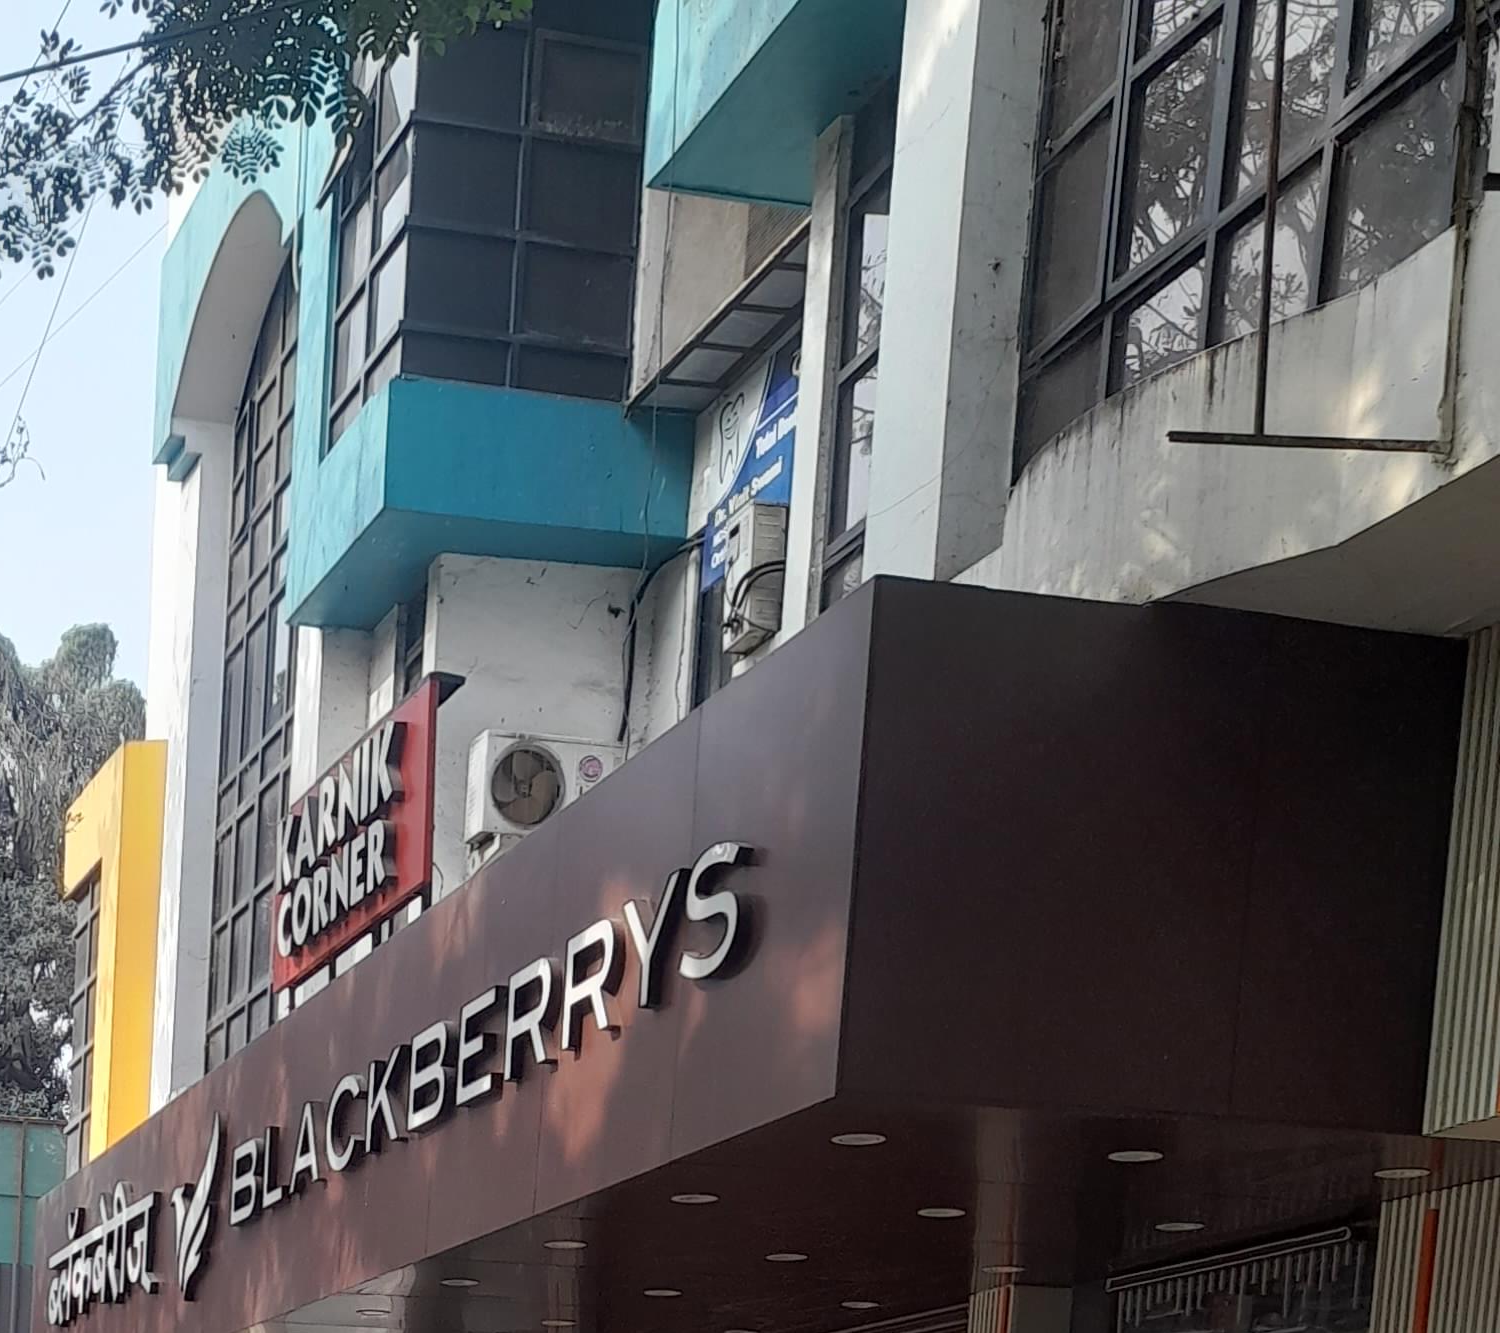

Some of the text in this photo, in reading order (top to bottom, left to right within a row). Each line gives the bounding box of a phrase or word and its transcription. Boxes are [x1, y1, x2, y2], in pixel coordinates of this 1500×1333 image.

[276, 719, 400, 893] KARNIK
[277, 818, 393, 958] CORNER
[229, 841, 754, 1227] BLACKBERRYS
